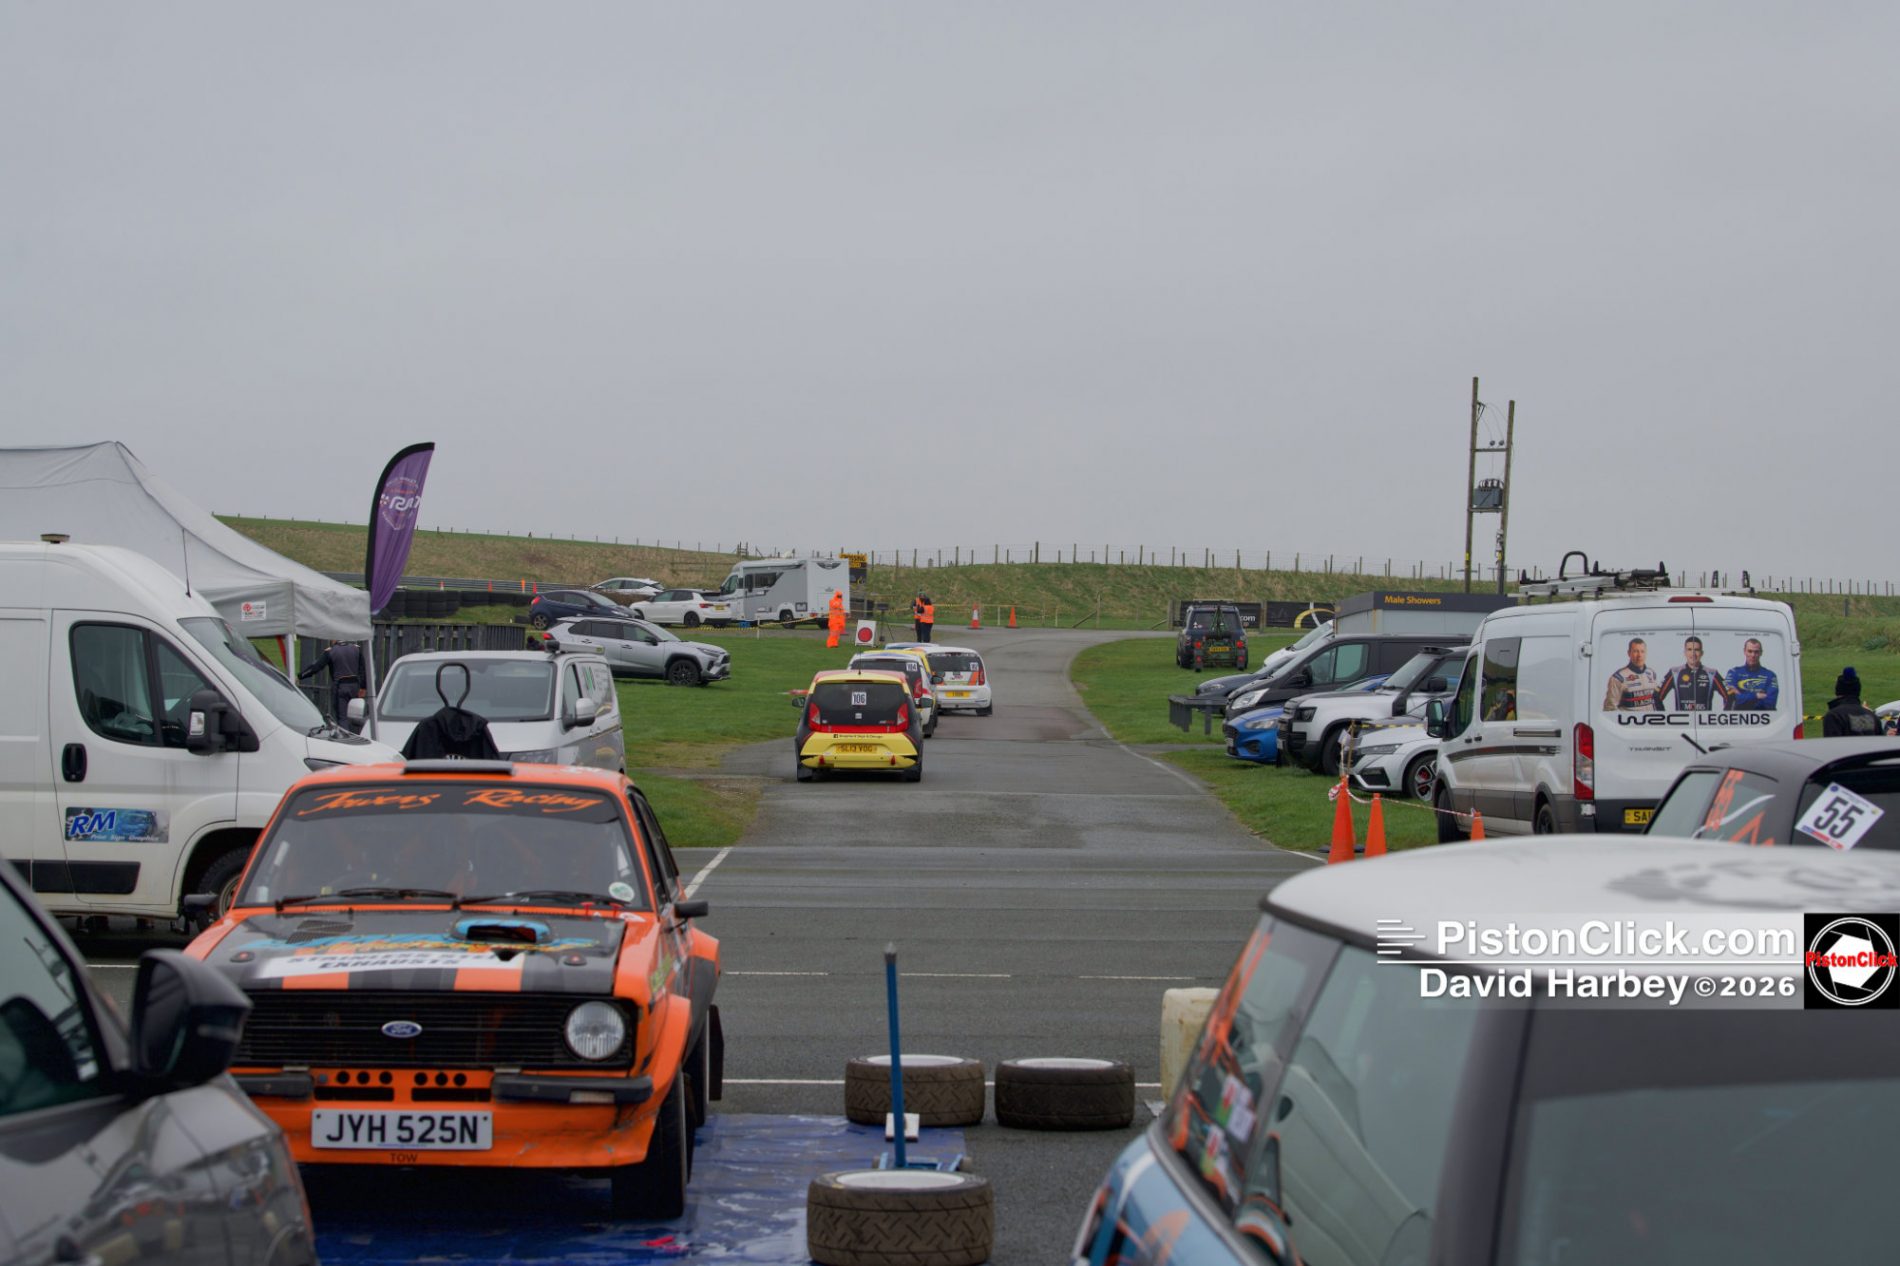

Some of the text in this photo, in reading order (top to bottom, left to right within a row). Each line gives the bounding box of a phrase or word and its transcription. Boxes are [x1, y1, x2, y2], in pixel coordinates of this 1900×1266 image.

[1384, 595, 1441, 605] Male Showers
[853, 692, 866, 704] 106
[1618, 713, 1771, 726] WRC LEGENDS
[463, 788, 604, 813] Racing
[1633, 811, 1656, 822] SA
[1813, 795, 1865, 839] 55
[70, 810, 116, 836] RM
[318, 958, 460, 969] EXHAUSTS
[326, 1114, 478, 1144] JYH 525N
[390, 1153, 418, 1162] TOW
